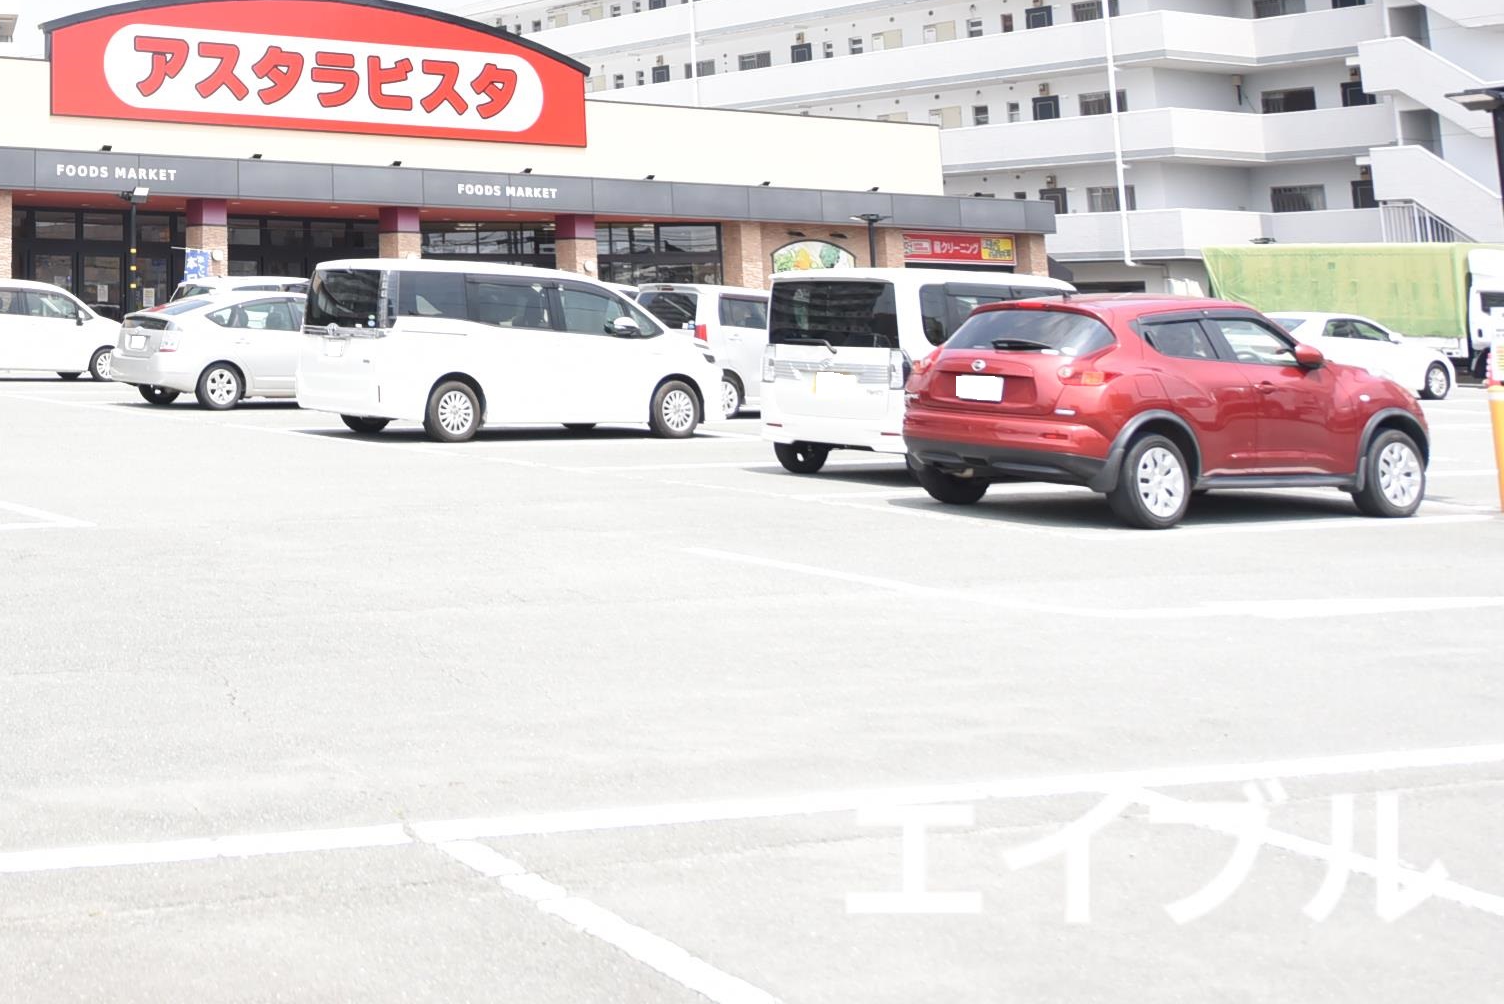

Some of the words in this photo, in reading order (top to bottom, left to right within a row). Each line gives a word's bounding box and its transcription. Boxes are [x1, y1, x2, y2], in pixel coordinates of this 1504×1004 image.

[134, 35, 518, 119] アスタラビスタ
[56, 164, 109, 178] FOODS
[114, 167, 177, 181] MARKET
[457, 183, 502, 197] FOODS
[505, 186, 558, 199] MARKET
